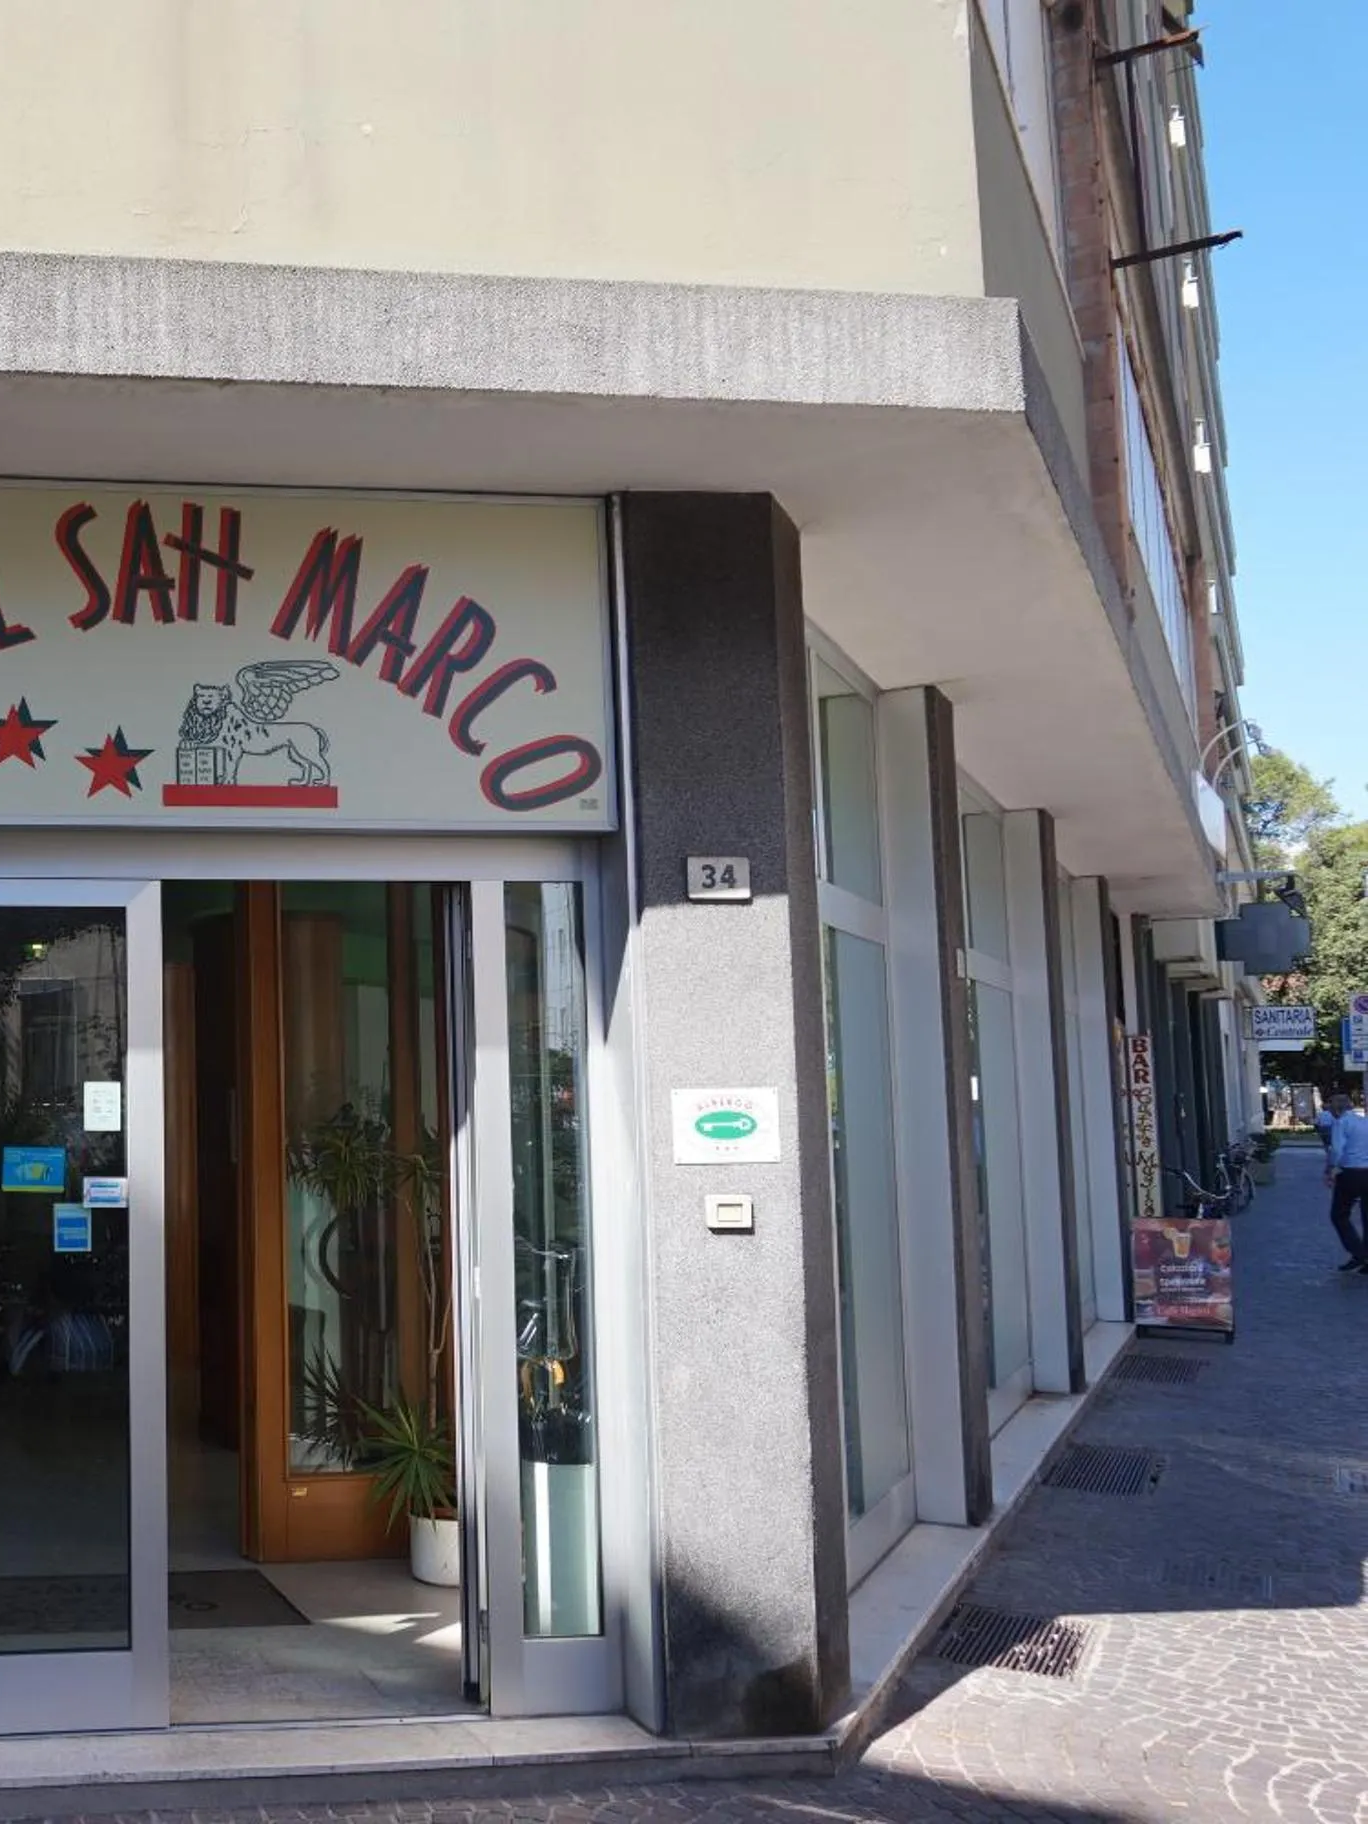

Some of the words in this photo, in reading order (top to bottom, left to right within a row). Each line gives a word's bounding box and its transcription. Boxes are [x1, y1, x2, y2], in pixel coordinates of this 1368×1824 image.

[270, 526, 603, 811] MARCO
[701, 864, 737, 889] 34
[1254, 1008, 1312, 1025] SANITARIA
[1132, 1039, 1150, 1084] BAR
